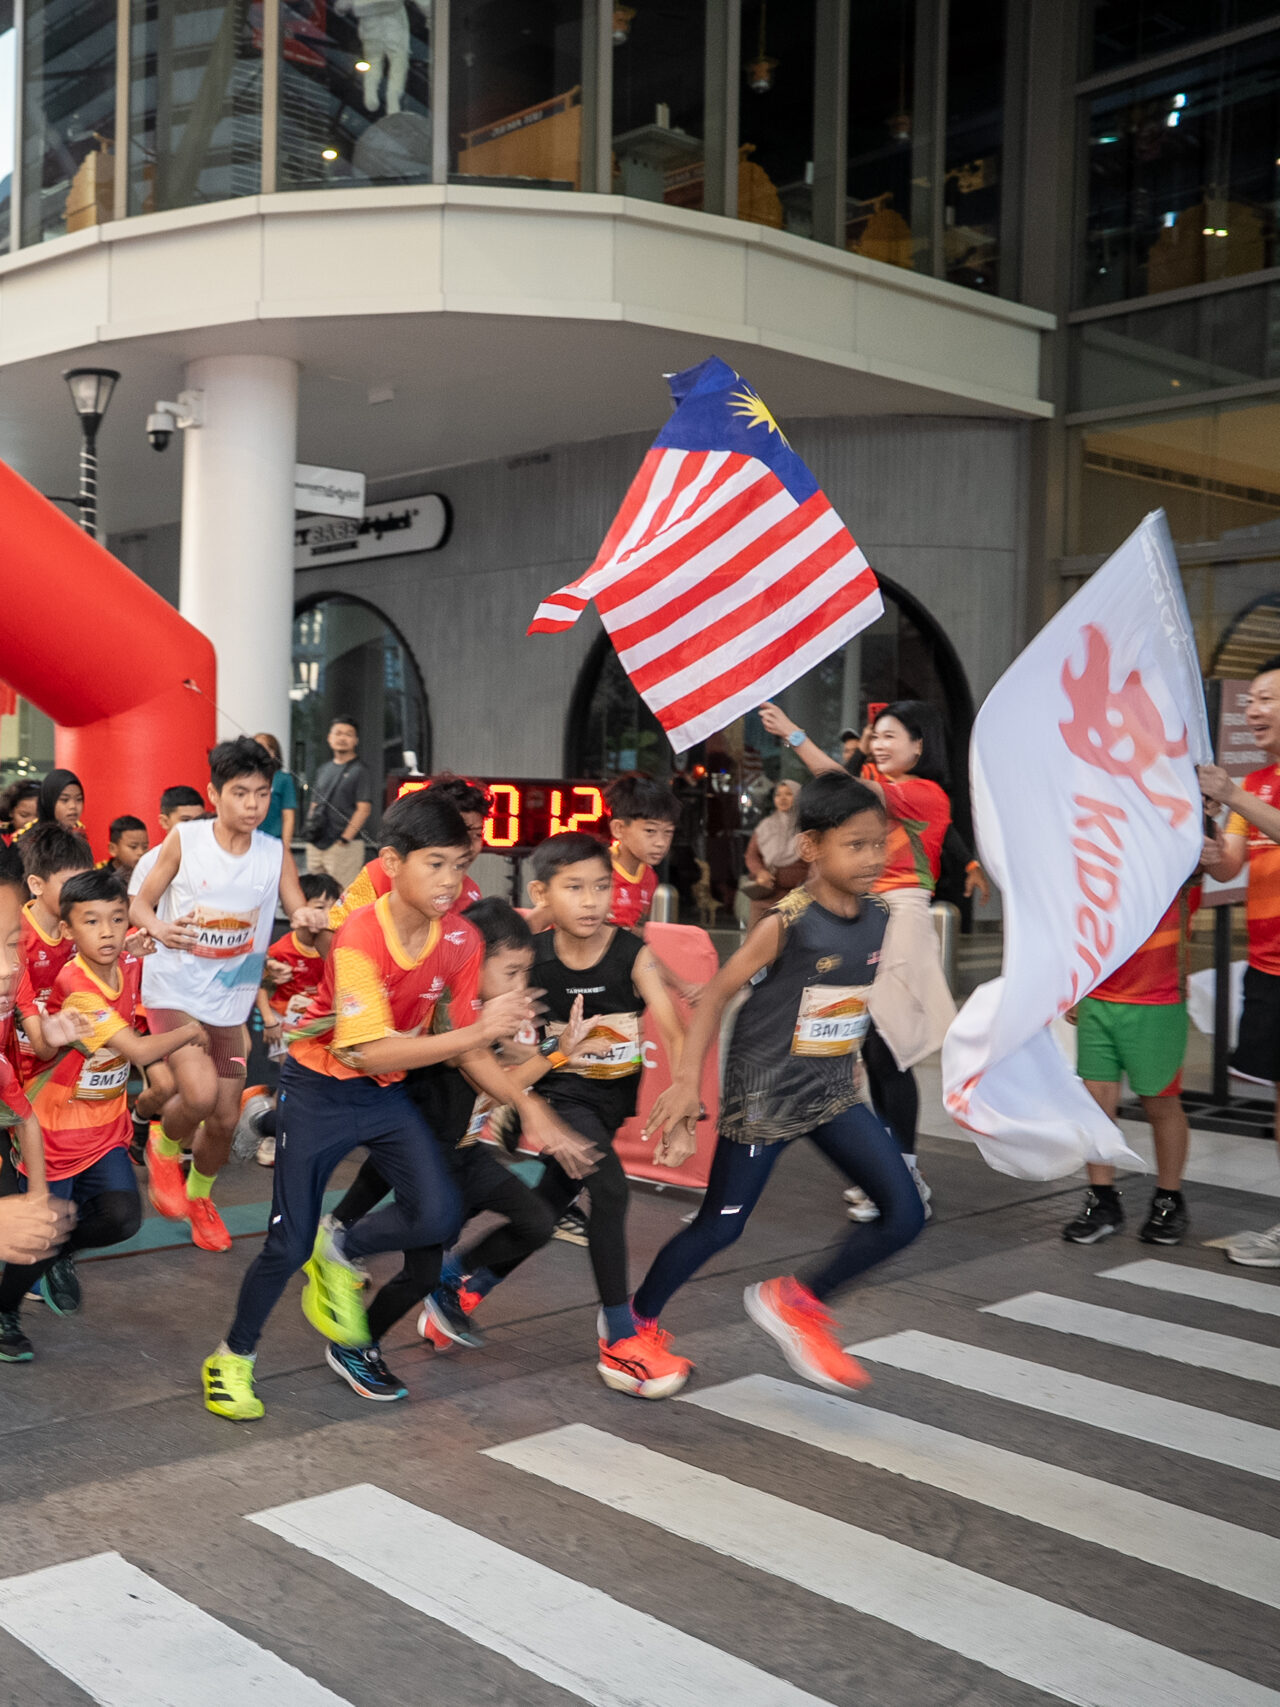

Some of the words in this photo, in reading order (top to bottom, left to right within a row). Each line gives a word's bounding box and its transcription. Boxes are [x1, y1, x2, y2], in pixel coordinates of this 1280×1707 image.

[200, 932, 223, 945] AM
[227, 931, 249, 945] 047
[809, 1023, 839, 1038] BM
[598, 1045, 629, 1061] 47
[89, 1073, 115, 1086] BM
